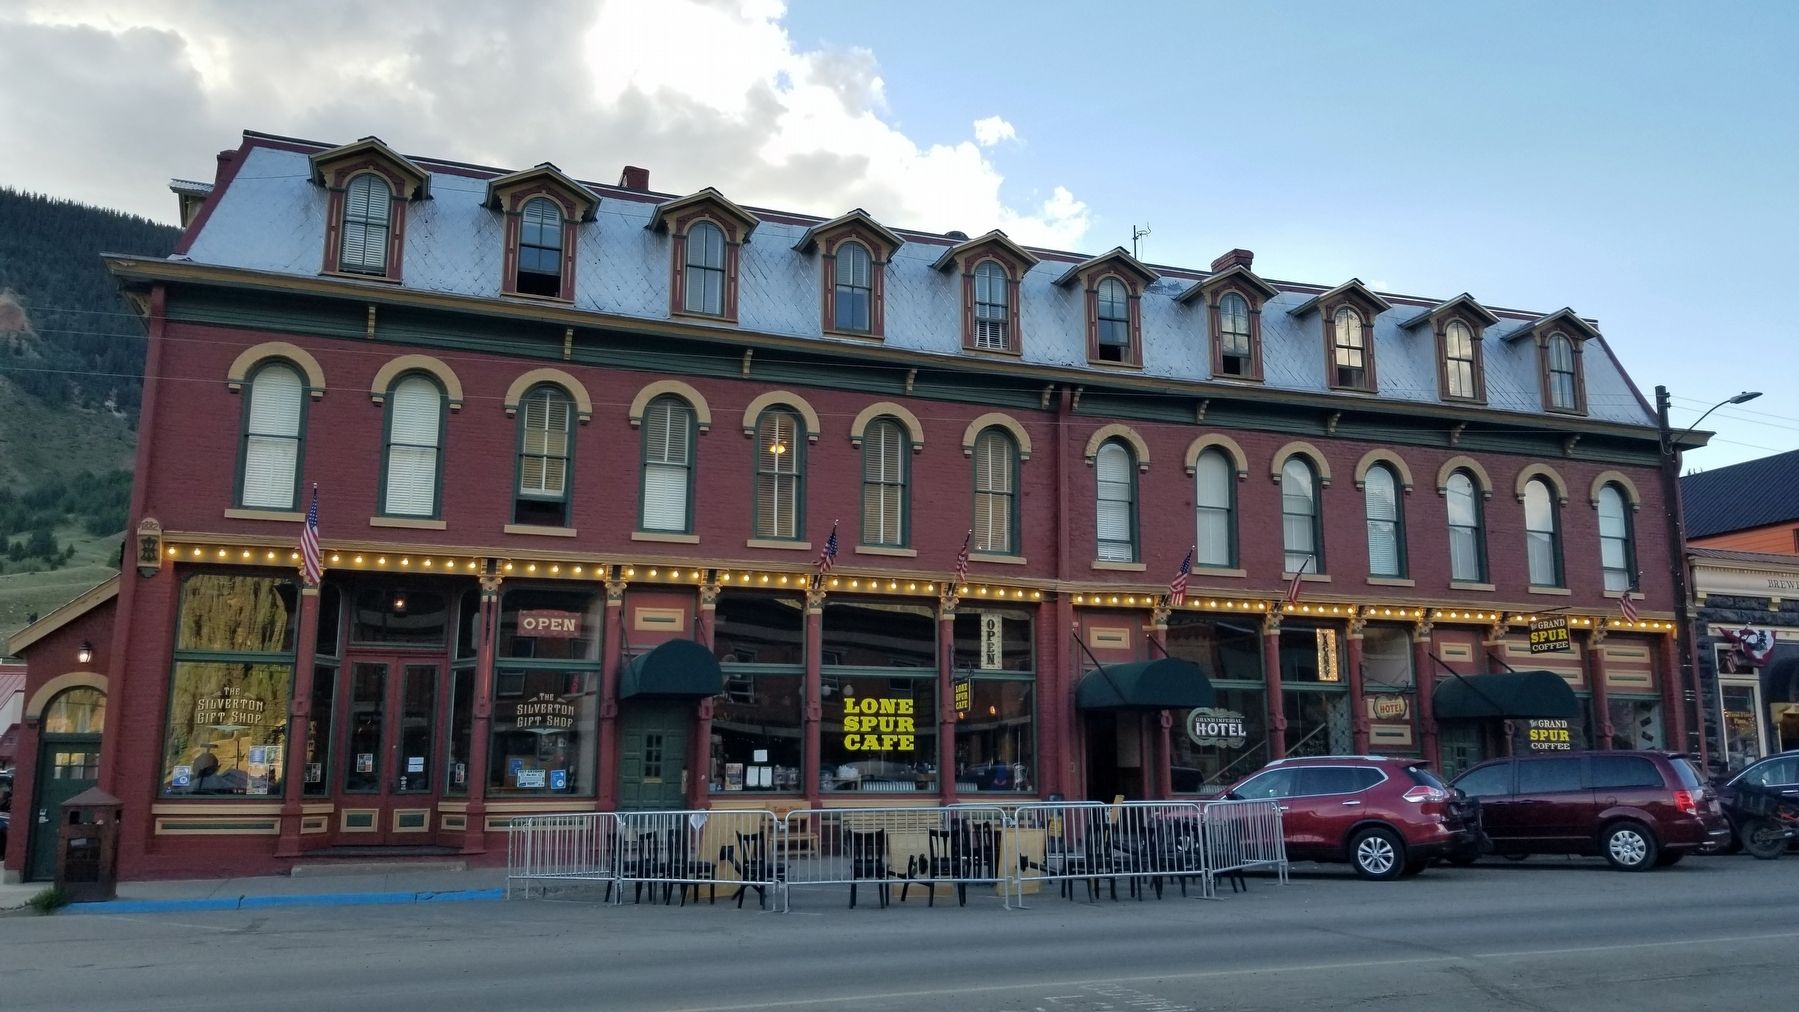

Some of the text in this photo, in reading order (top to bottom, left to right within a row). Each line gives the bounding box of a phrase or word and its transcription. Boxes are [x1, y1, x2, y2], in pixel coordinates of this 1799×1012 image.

[523, 618, 576, 632] OPEN
[1538, 618, 1565, 629] GRAND
[1531, 628, 1567, 643] SPUR
[986, 619, 996, 666] OPEN
[1532, 641, 1568, 651] COFFEE
[224, 687, 241, 696] THE
[540, 693, 555, 701] THE
[198, 699, 264, 711] SILVERTON
[517, 704, 575, 716] SILVERTON
[844, 698, 914, 714] LONE
[1380, 703, 1403, 713] HOTEL
[197, 711, 261, 724] GIFT SHOP
[517, 715, 574, 728] GIFT SHOP
[844, 716, 915, 732] SPUR
[1196, 722, 1247, 737] HOTEL
[1538, 720, 1567, 728] GRAND
[1530, 729, 1569, 741] SPUR
[844, 734, 915, 751] CAFE
[1531, 742, 1570, 750] COFFEE
